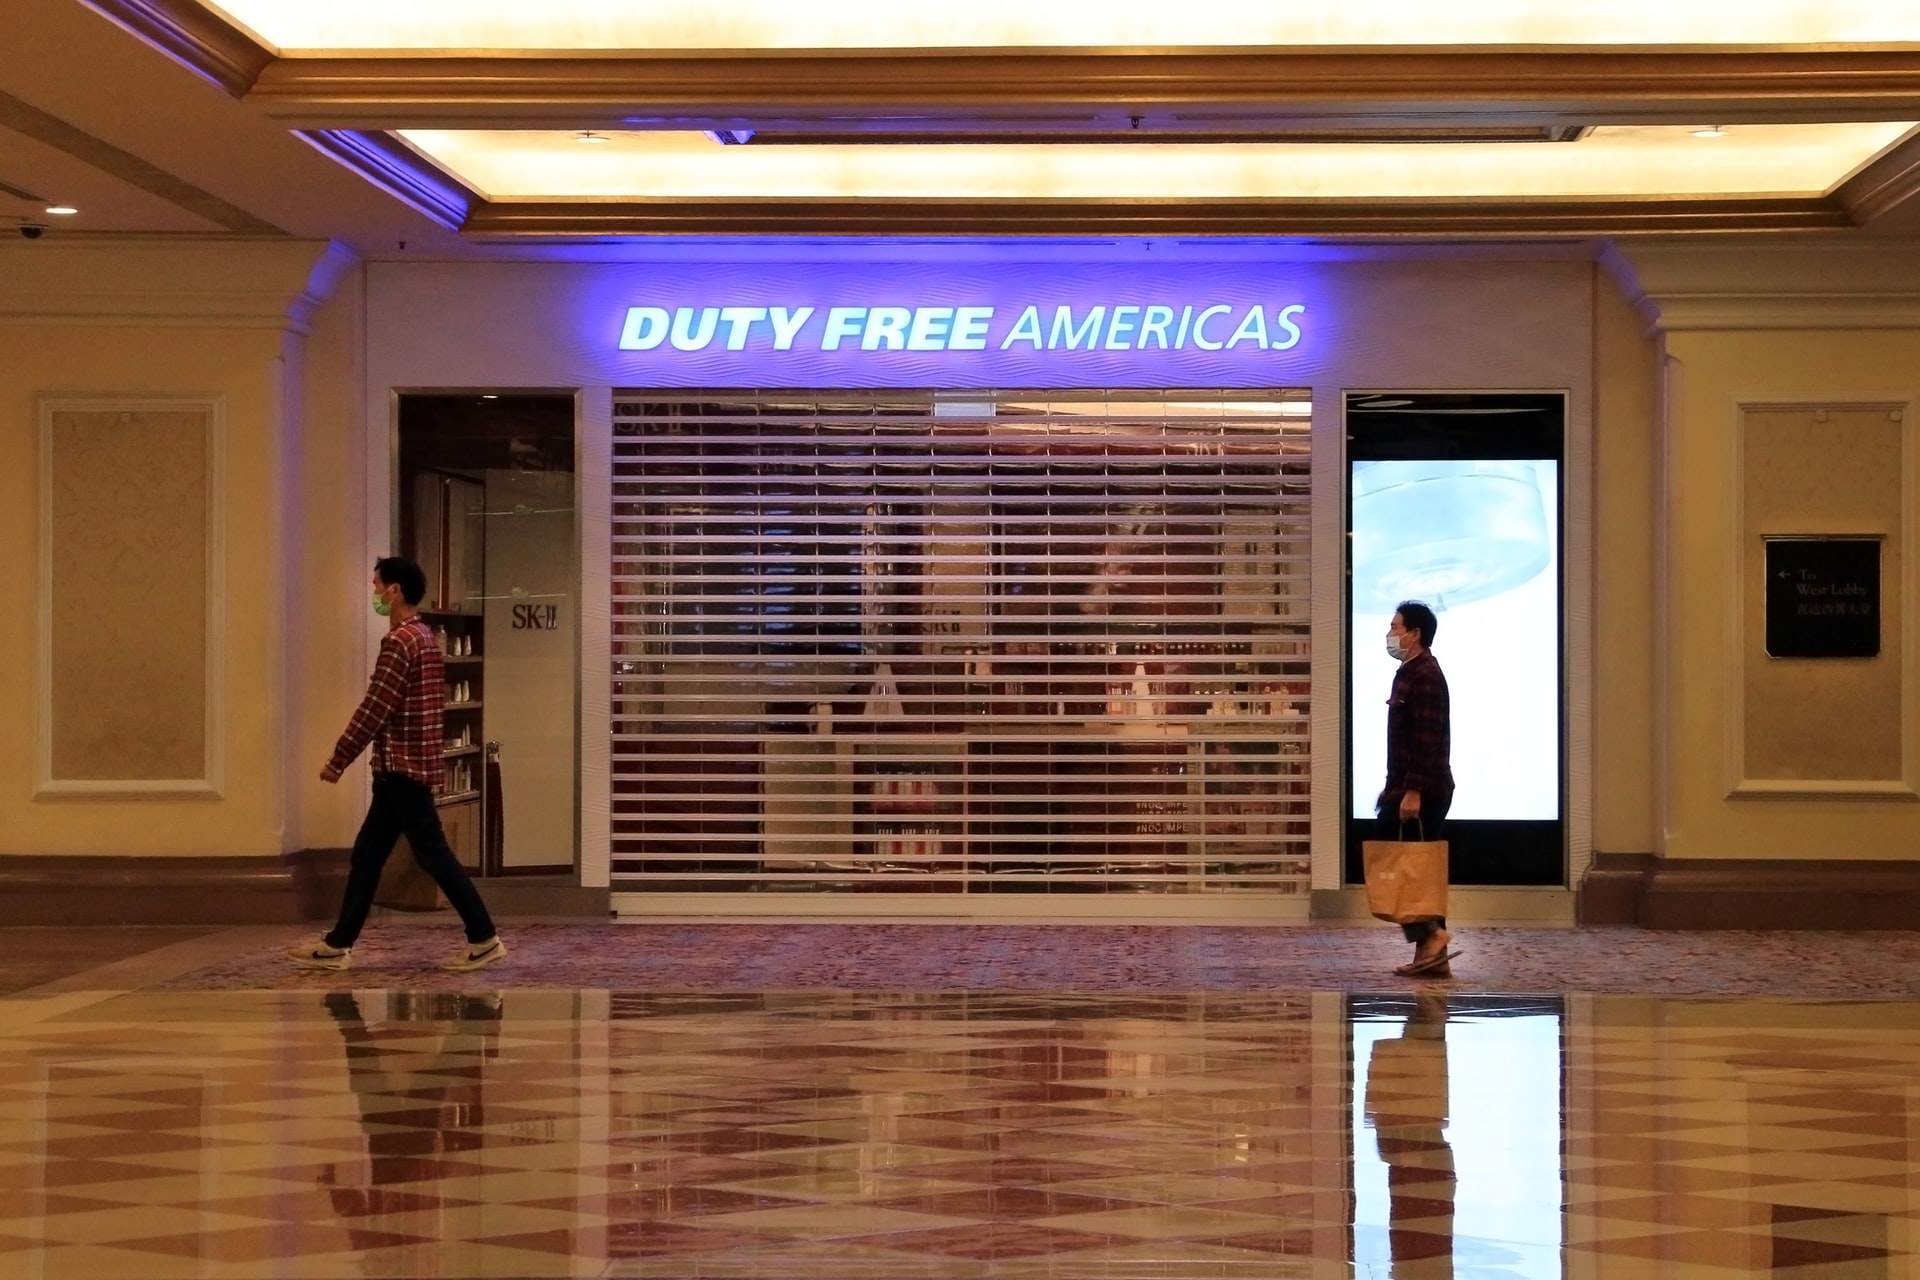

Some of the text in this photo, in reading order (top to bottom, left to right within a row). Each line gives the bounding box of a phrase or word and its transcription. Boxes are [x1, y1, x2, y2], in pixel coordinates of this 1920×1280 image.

[618, 304, 1306, 351] DUTY FREE AMERICAS
[1799, 568, 1817, 581] To
[1831, 583, 1867, 597] Lobby
[512, 603, 558, 630] SK-II
